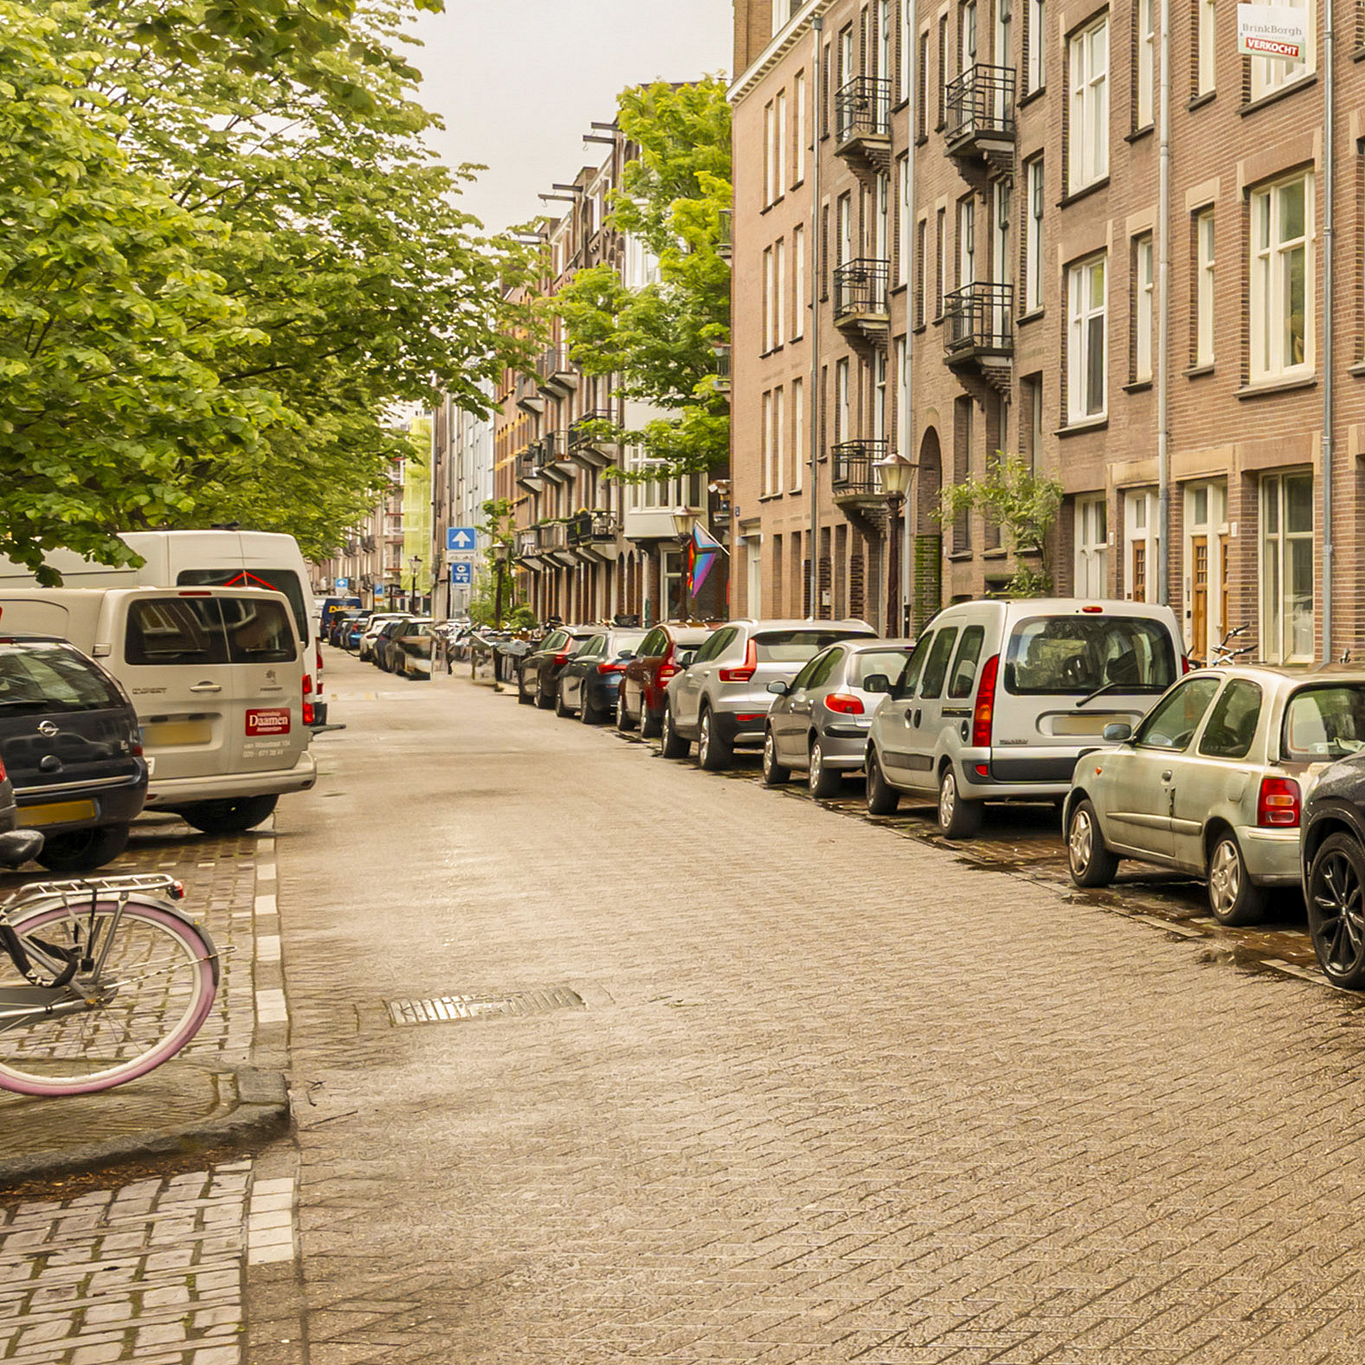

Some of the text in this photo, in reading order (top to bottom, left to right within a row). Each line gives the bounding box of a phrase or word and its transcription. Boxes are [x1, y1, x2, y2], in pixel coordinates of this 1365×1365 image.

[1242, 23, 1303, 36] BrinkBorgh
[1247, 38, 1297, 55] VERKOCHT
[249, 714, 289, 727] Daamen
